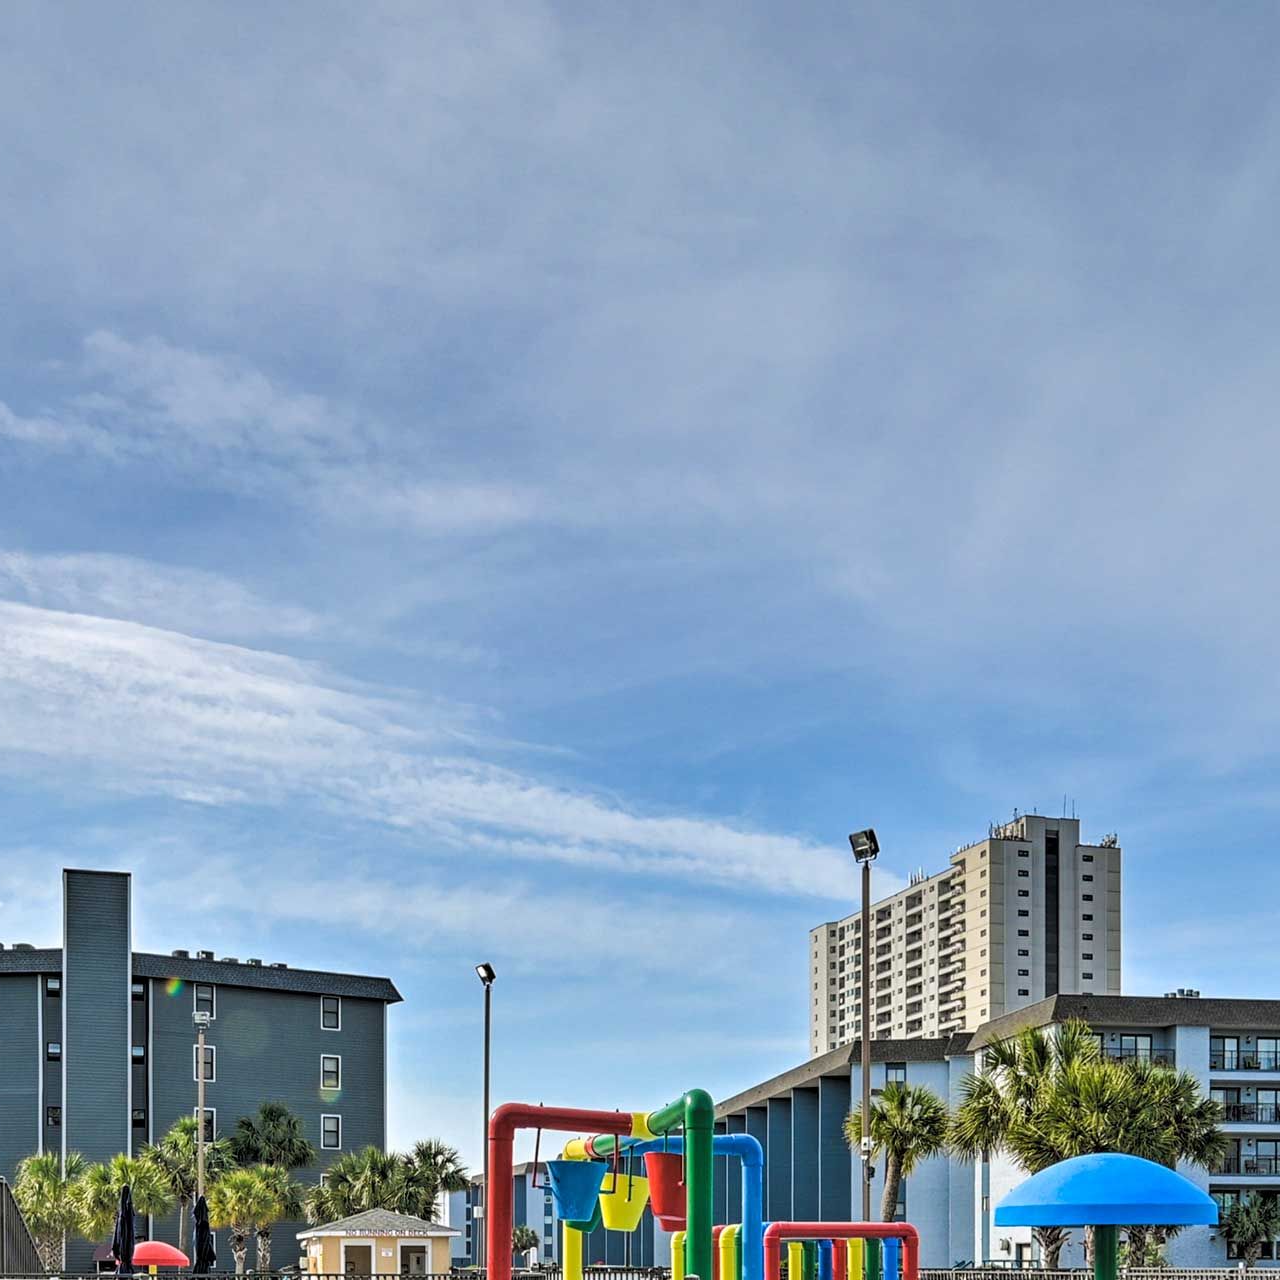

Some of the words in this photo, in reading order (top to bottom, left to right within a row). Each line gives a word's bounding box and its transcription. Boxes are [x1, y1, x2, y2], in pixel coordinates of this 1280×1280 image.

[346, 1229, 356, 1237] NO
[360, 1229, 393, 1237] RUNNING
[395, 1229, 406, 1237] ON
[409, 1229, 429, 1237] DECK
